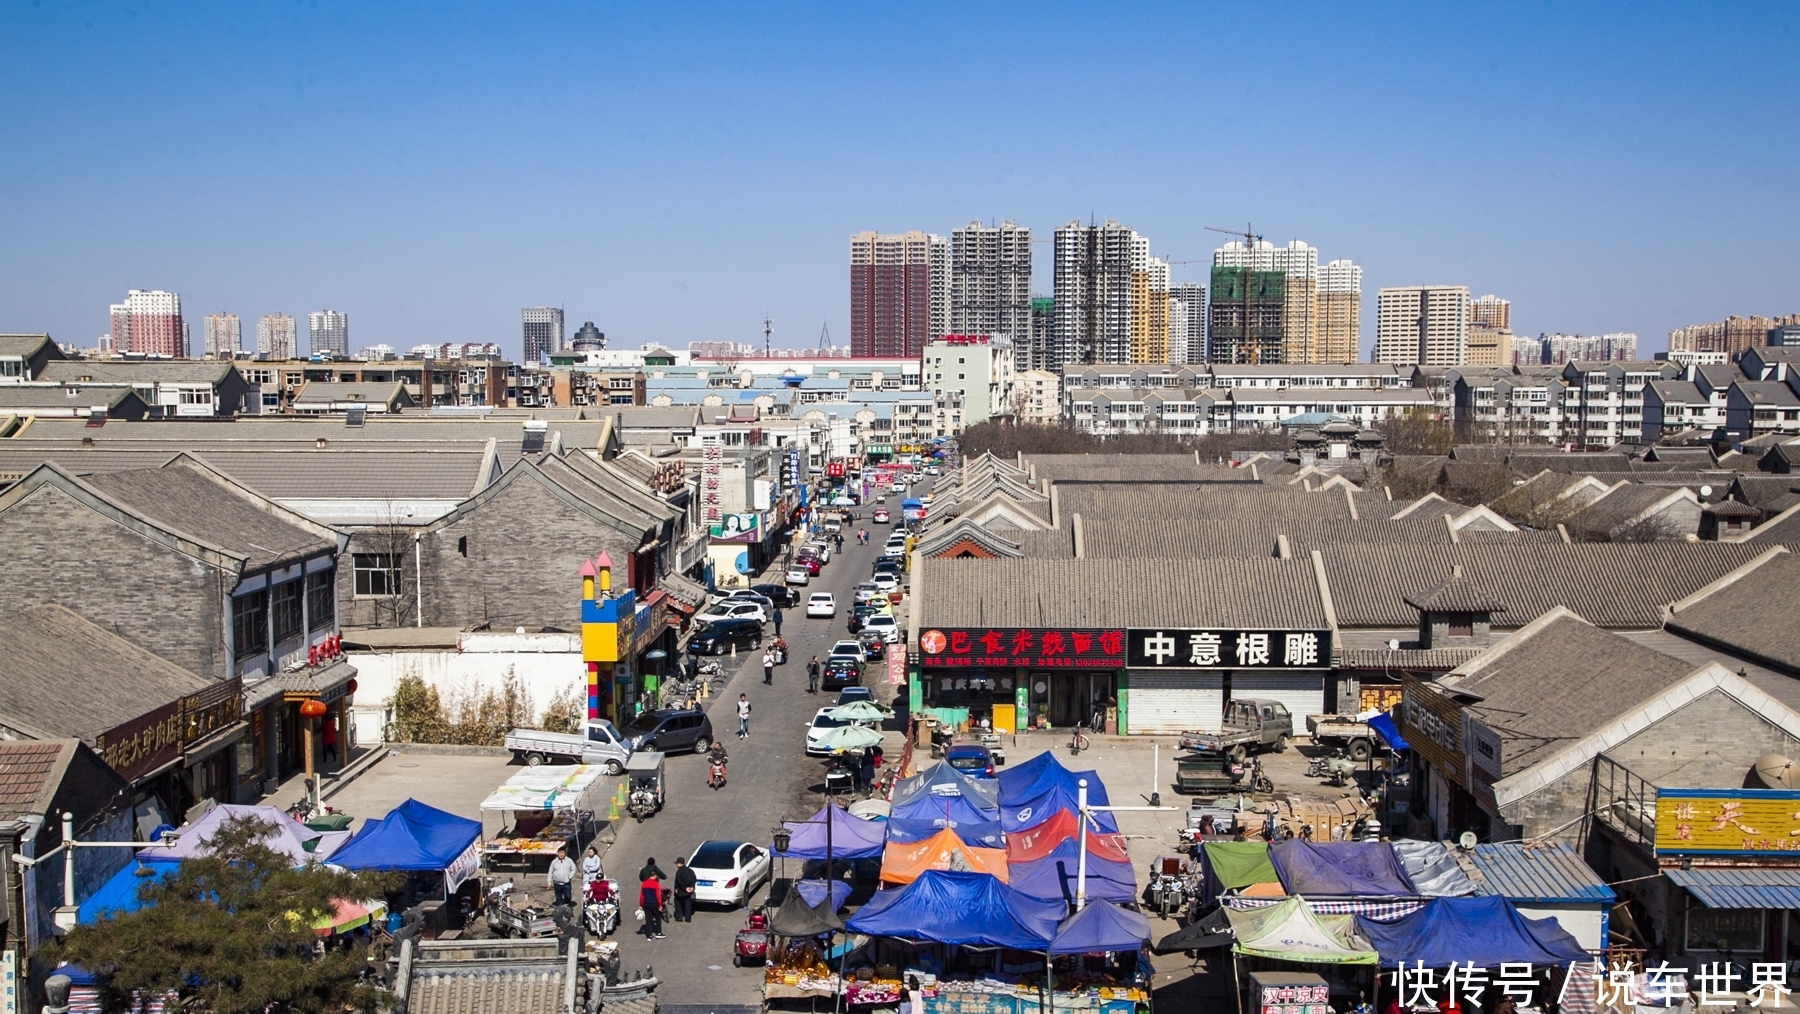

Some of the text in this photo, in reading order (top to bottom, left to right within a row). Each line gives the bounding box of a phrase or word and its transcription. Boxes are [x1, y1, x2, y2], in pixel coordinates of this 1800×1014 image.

[950, 629, 1124, 656] 巴食米线面馆
[1144, 632, 1318, 665] 中意根雕
[1675, 803, 1694, 840] 批发
[1264, 985, 1328, 1004] 汉中凉皮
